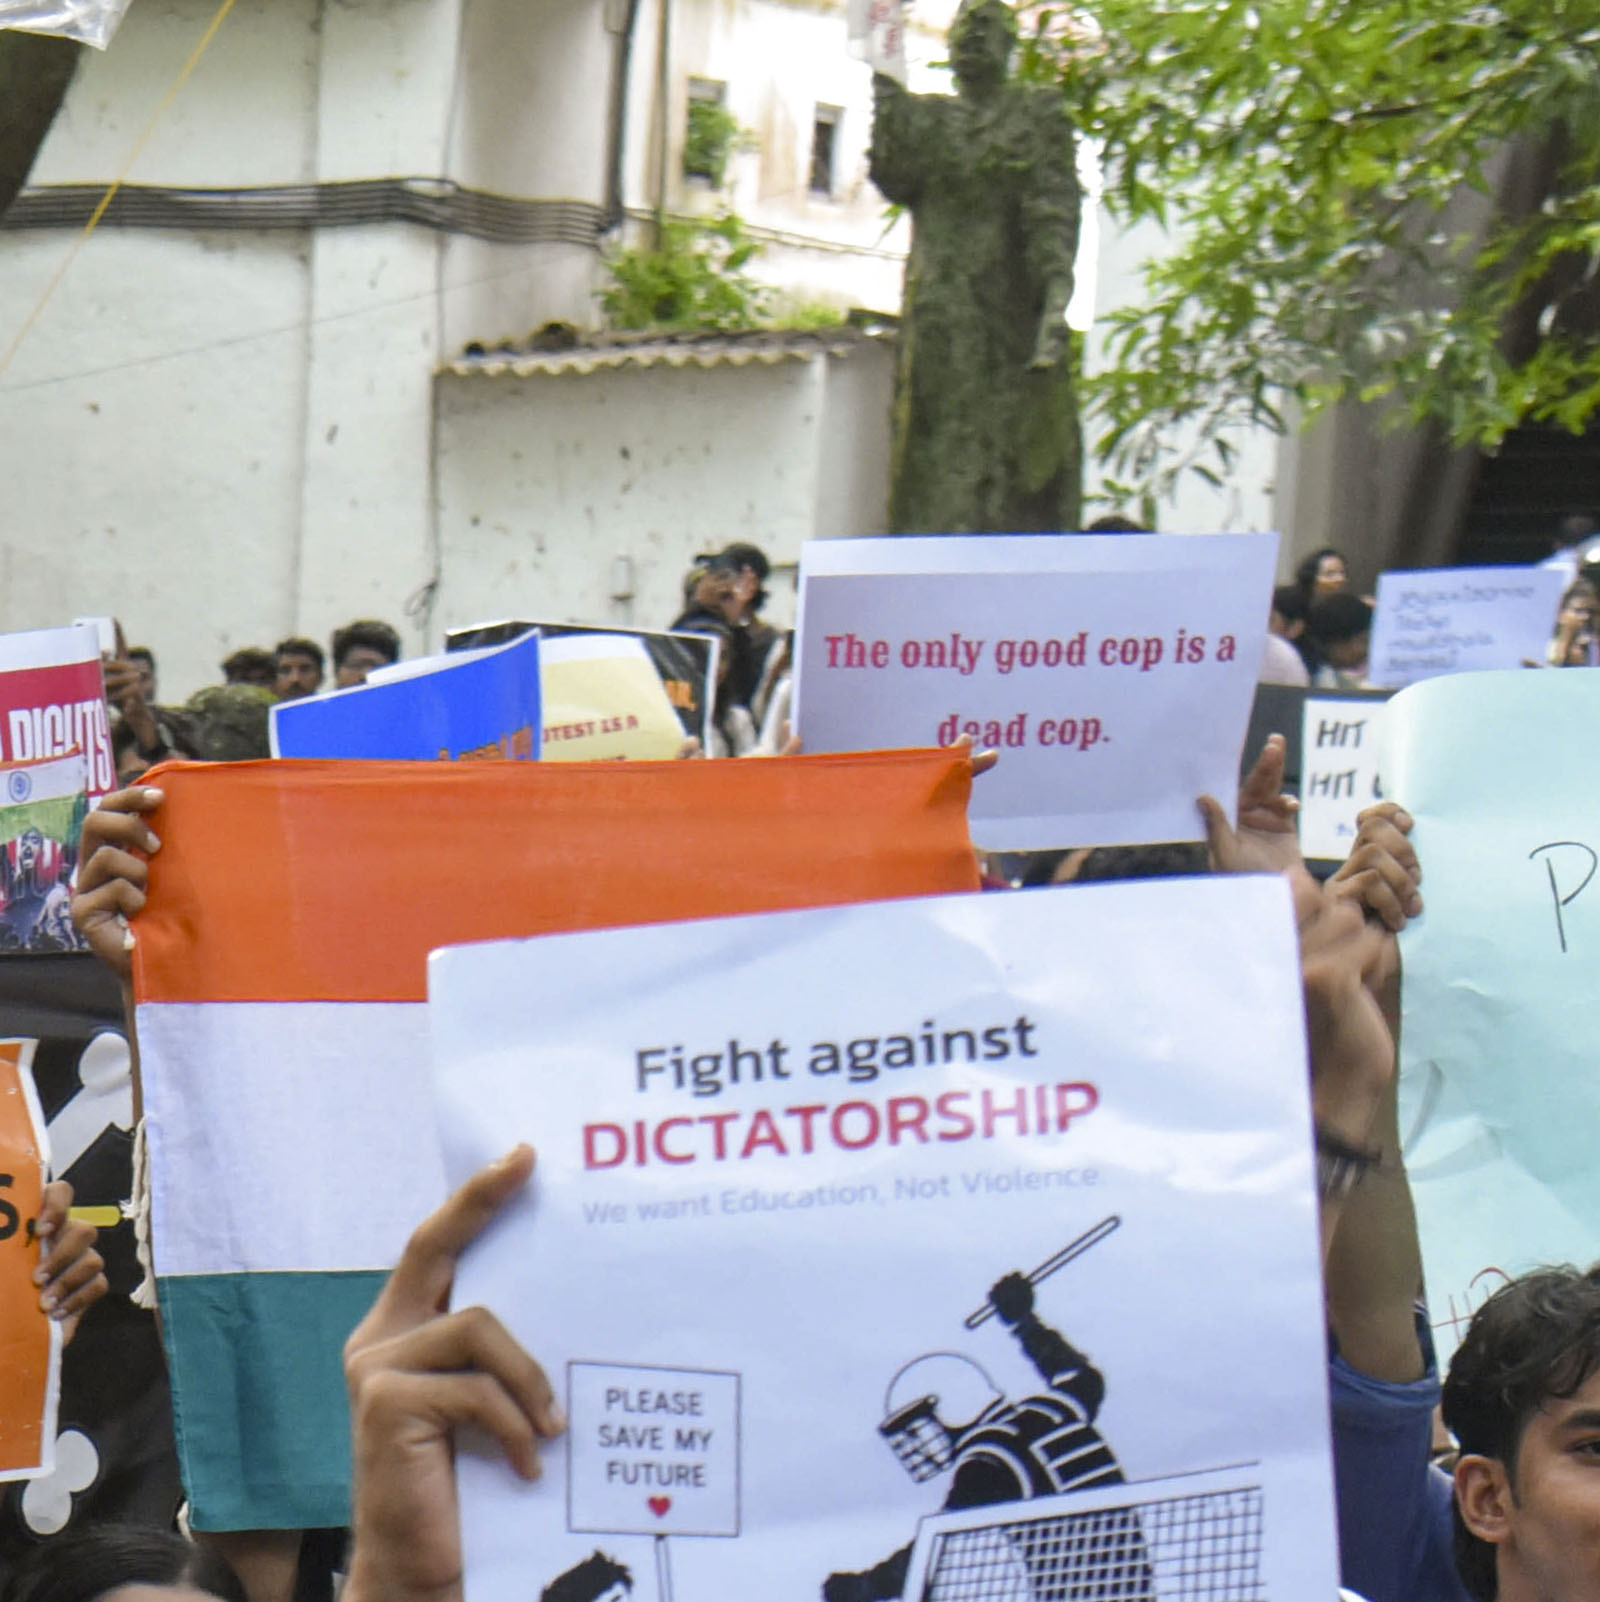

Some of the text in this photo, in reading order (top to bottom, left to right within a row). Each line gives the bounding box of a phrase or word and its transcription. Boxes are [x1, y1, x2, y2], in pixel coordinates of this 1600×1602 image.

[825, 629, 1237, 676] The only good cop is a
[544, 722, 595, 743] TEST
[601, 719, 623, 734] IS
[937, 713, 1111, 751] dead cop.
[1316, 719, 1366, 748] HIT
[1309, 769, 1356, 799] HIT
[634, 1015, 1039, 1098] Fight against
[582, 1080, 1102, 1171] DICTATORSHIP
[583, 1199, 629, 1225] We
[637, 1194, 712, 1221] want
[720, 1178, 885, 1216] Education,
[894, 1174, 951, 1201] Not
[604, 1387, 703, 1417] PLEASE
[598, 1423, 714, 1453] SAVE MY
[605, 1461, 708, 1488] FUTURE
